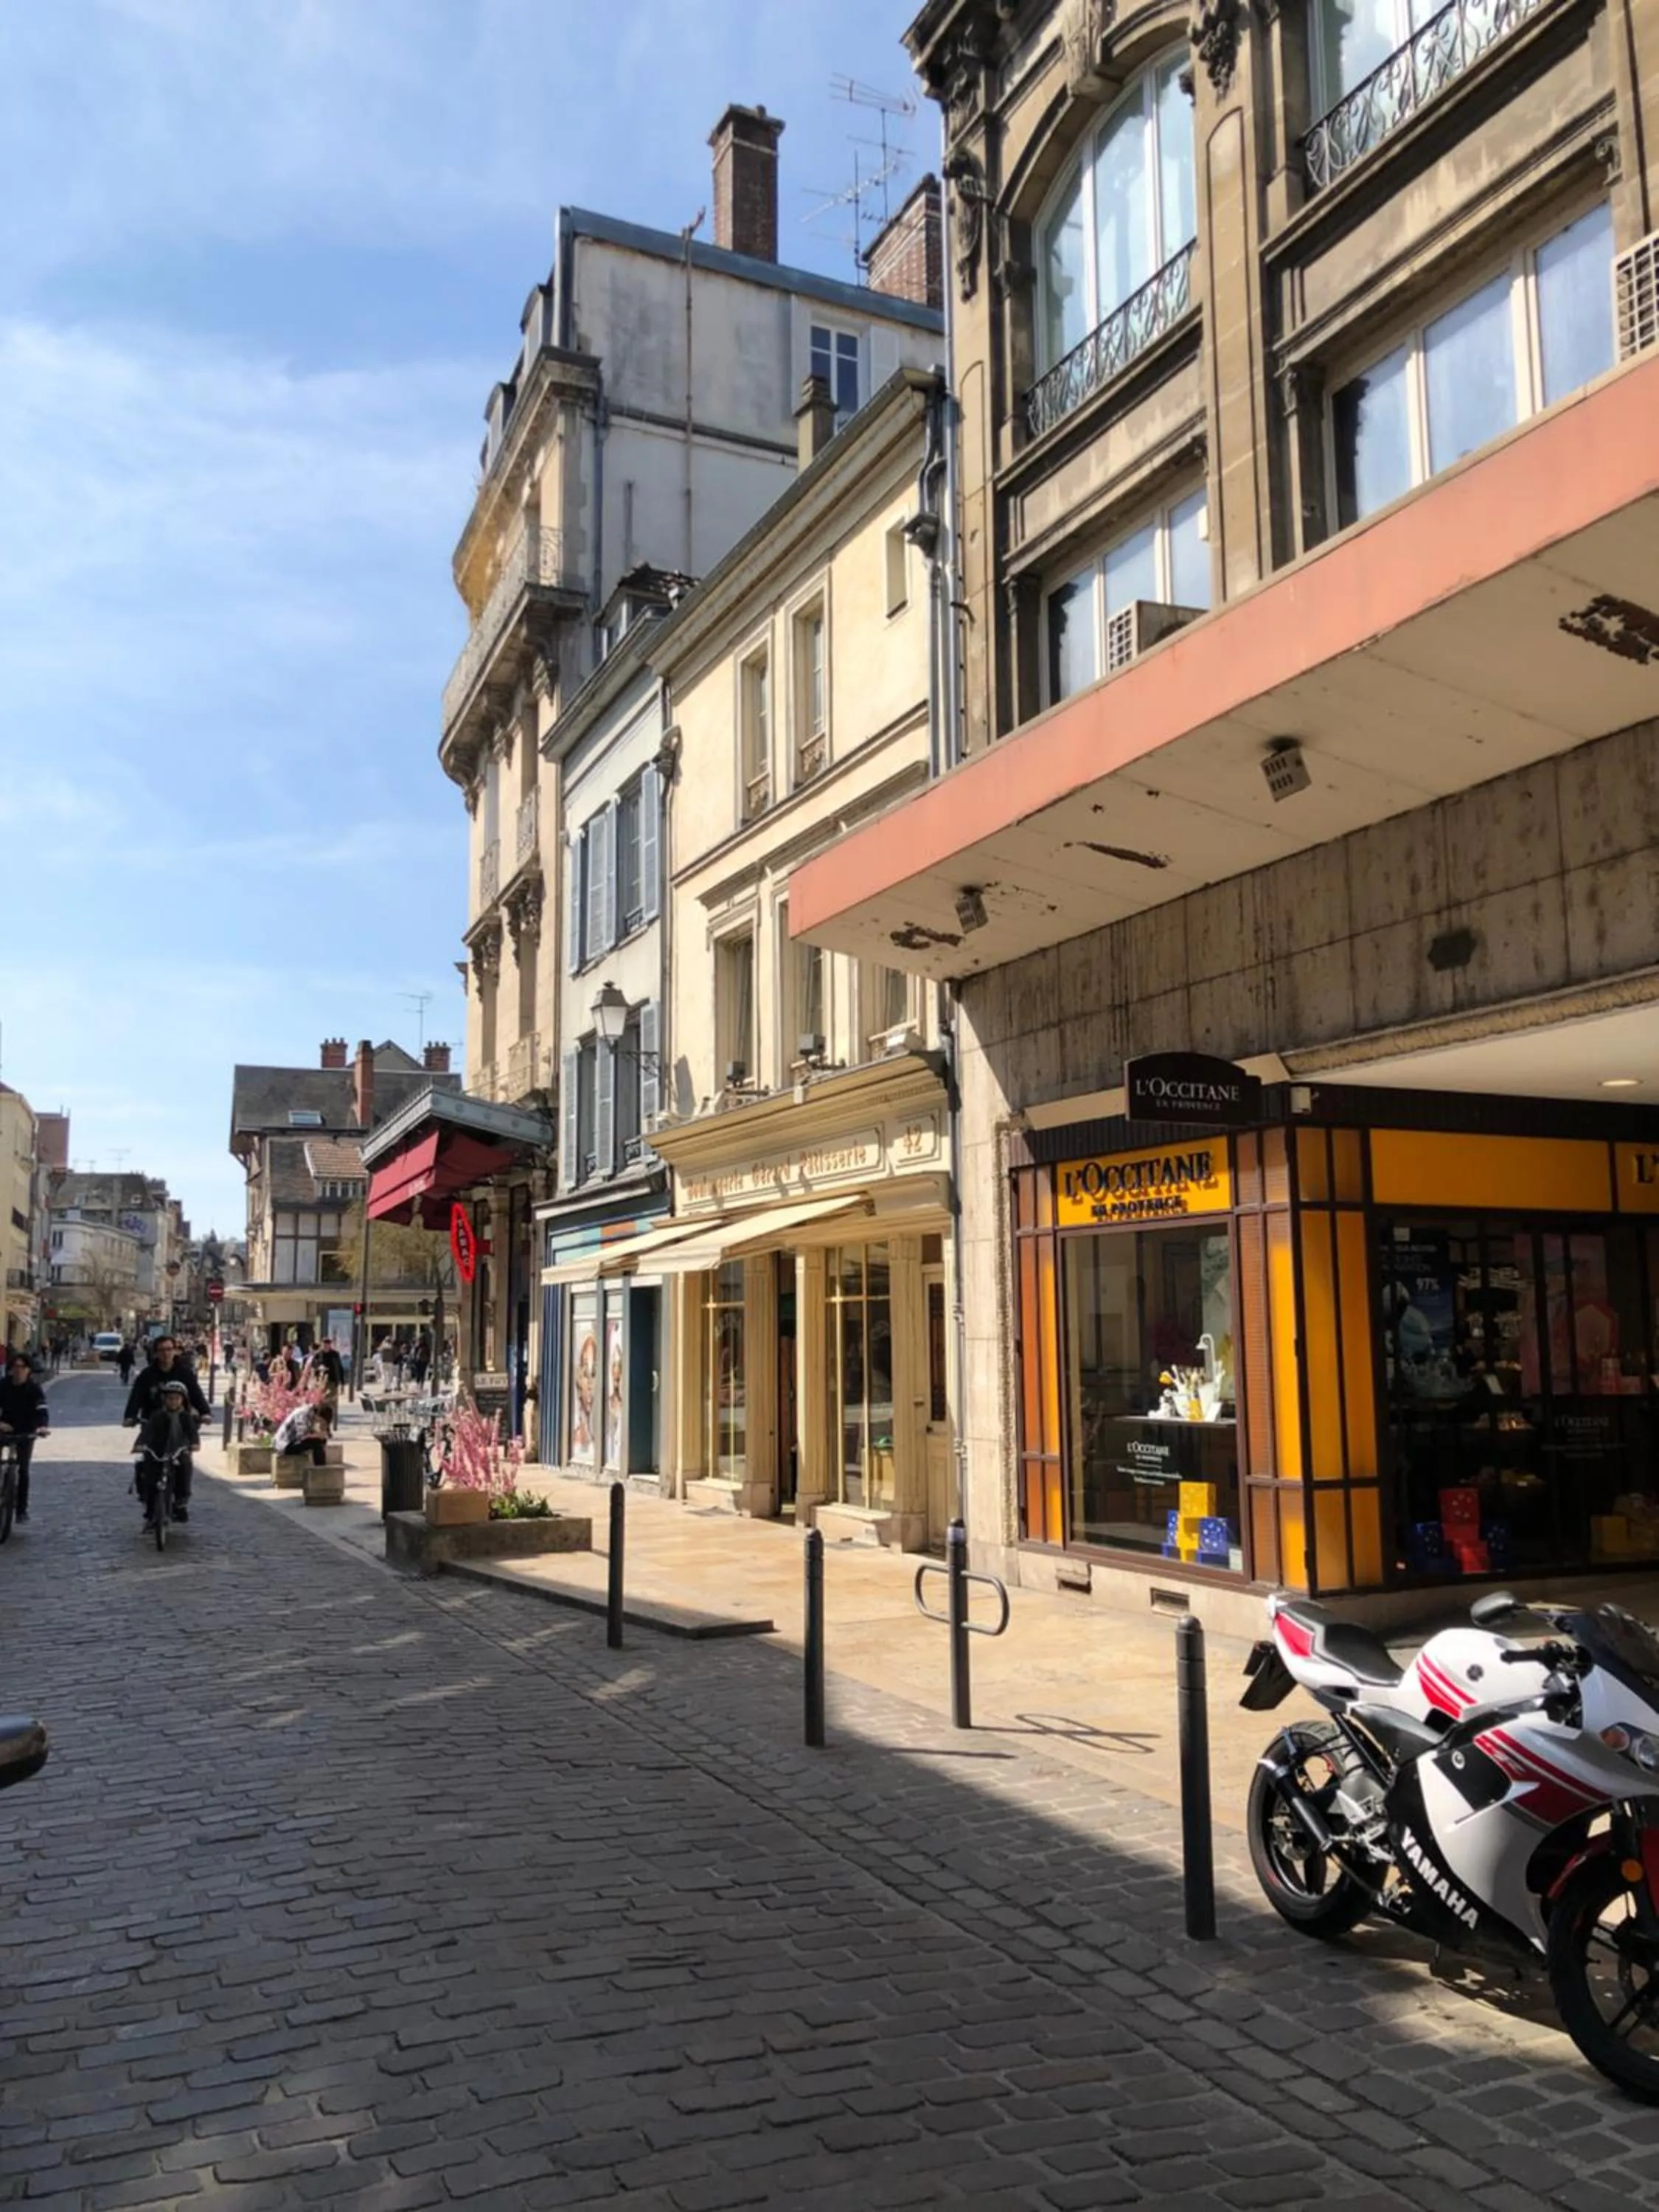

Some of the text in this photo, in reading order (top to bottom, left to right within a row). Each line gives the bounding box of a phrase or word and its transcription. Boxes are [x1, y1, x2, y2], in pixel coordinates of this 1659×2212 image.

[1135, 1077, 1239, 1101] L'OCCITANE
[1065, 1152, 1211, 1199] L'OCCITANE
[1402, 1826, 1479, 1930] YAMAHA
